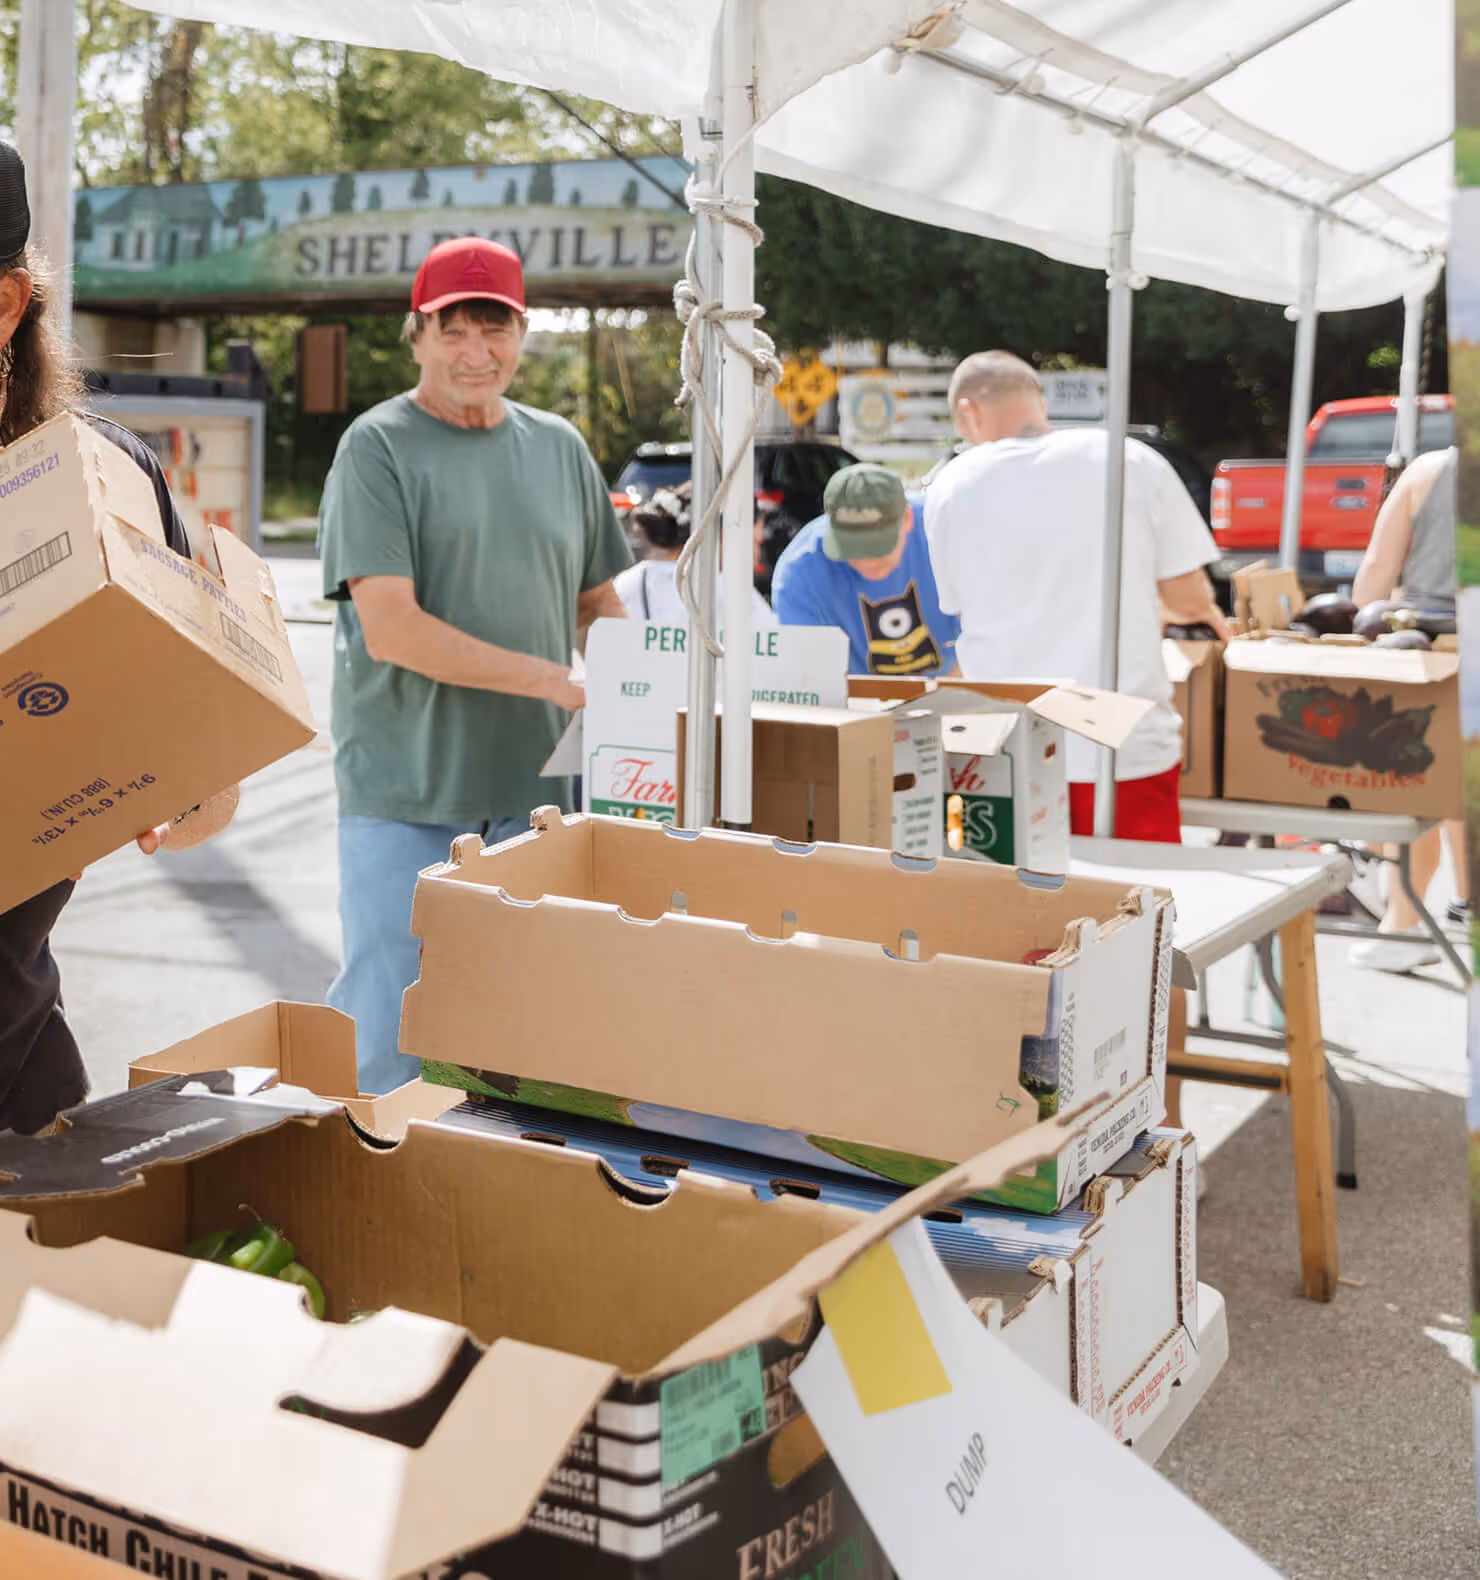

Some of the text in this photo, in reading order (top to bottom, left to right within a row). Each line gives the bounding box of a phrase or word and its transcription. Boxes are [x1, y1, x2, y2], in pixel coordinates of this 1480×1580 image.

[296, 224, 679, 276] SHELVILLE
[0, 452, 61, 498] 009356121
[140, 537, 198, 585] SAUSAGE
[644, 625, 780, 657] PERLE
[621, 681, 651, 697] KEEP
[610, 757, 676, 804] Far
[551, 1467, 597, 1491] HOT
[945, 1431, 987, 1515] DUMP
[7, 1478, 110, 1558] HATCH
[535, 1500, 599, 1532] X-HOT
[735, 1487, 835, 1580] FRESH
